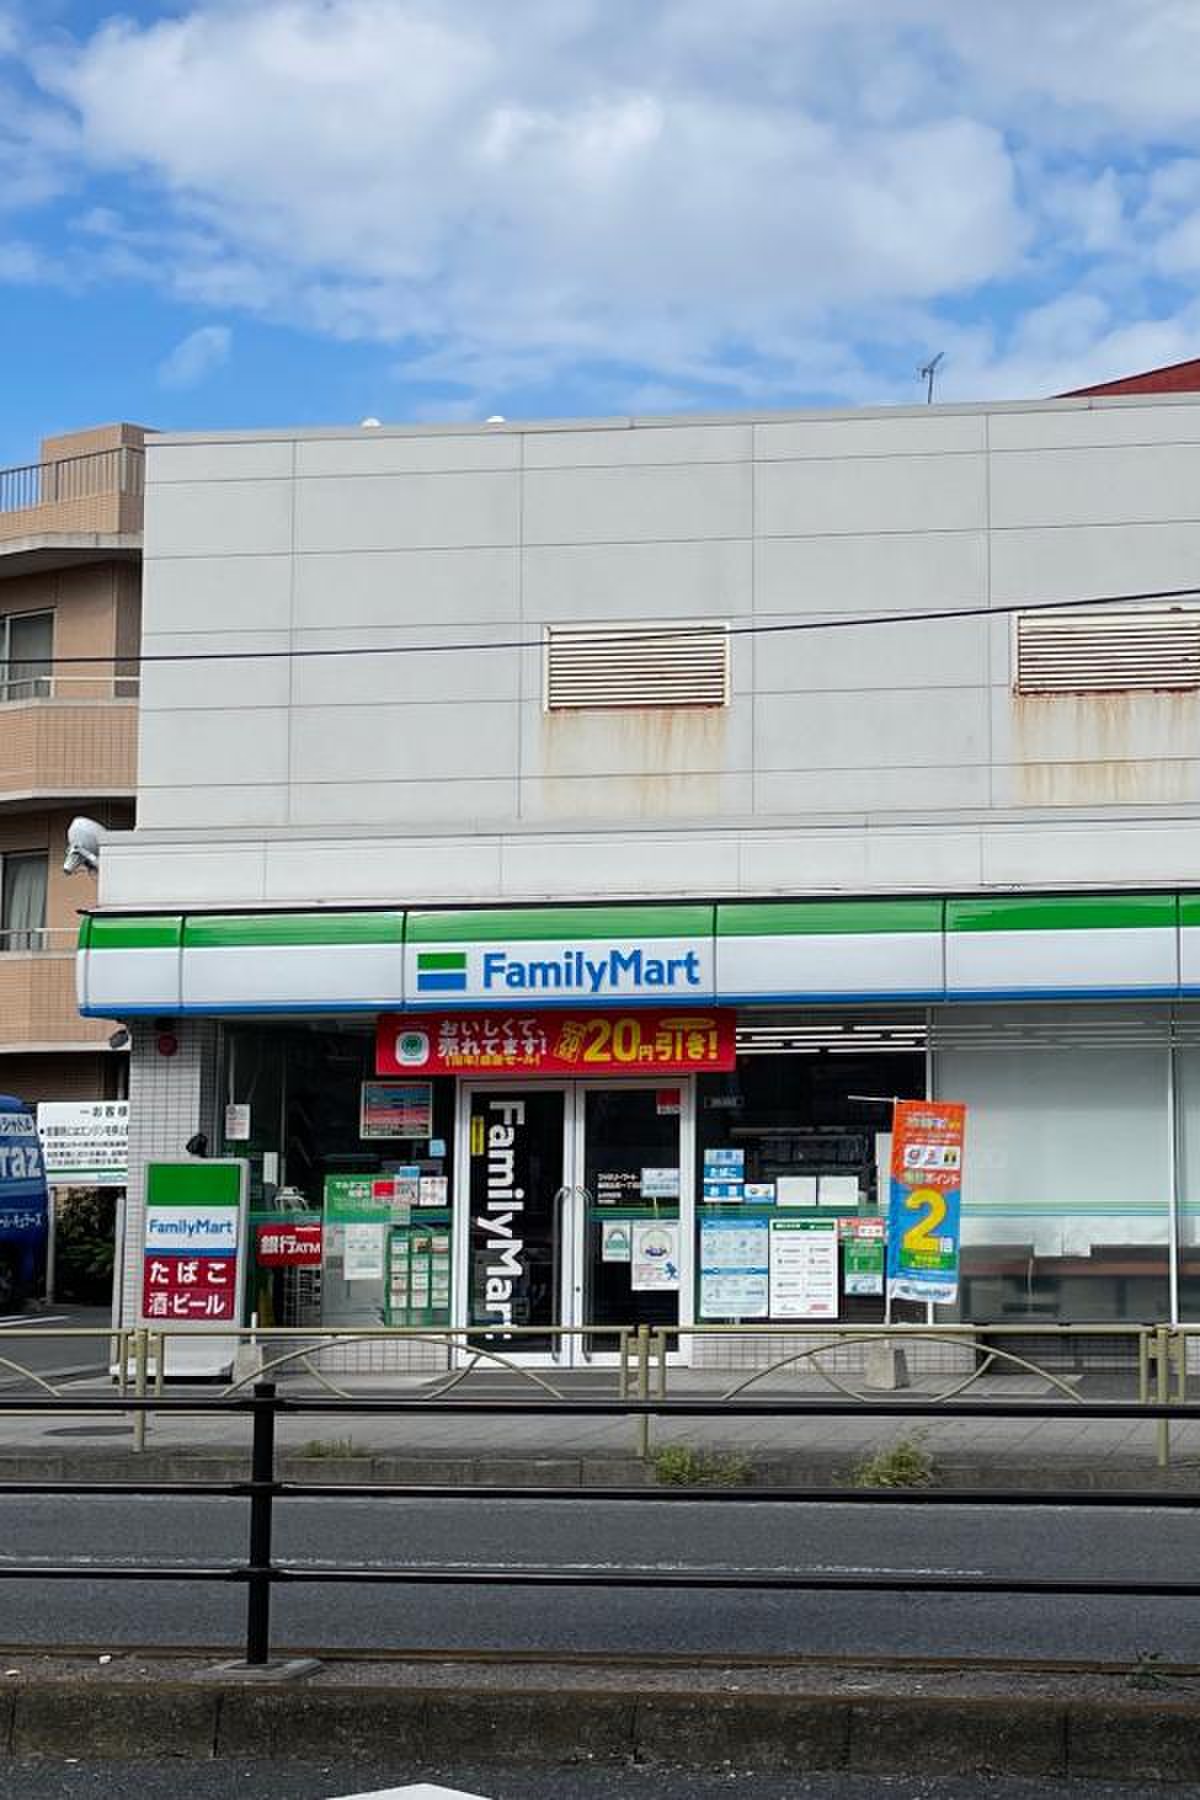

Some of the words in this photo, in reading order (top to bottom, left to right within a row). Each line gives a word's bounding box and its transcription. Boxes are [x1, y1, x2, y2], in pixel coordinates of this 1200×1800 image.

[482, 949, 701, 992] FamilyMart
[440, 1019, 547, 1037] おいしくて、
[437, 1037, 548, 1058] 売れてます!
[149, 1218, 234, 1238] FamilyMart
[260, 1234, 321, 1255] 銀行ATM
[149, 1261, 227, 1284] たばこ
